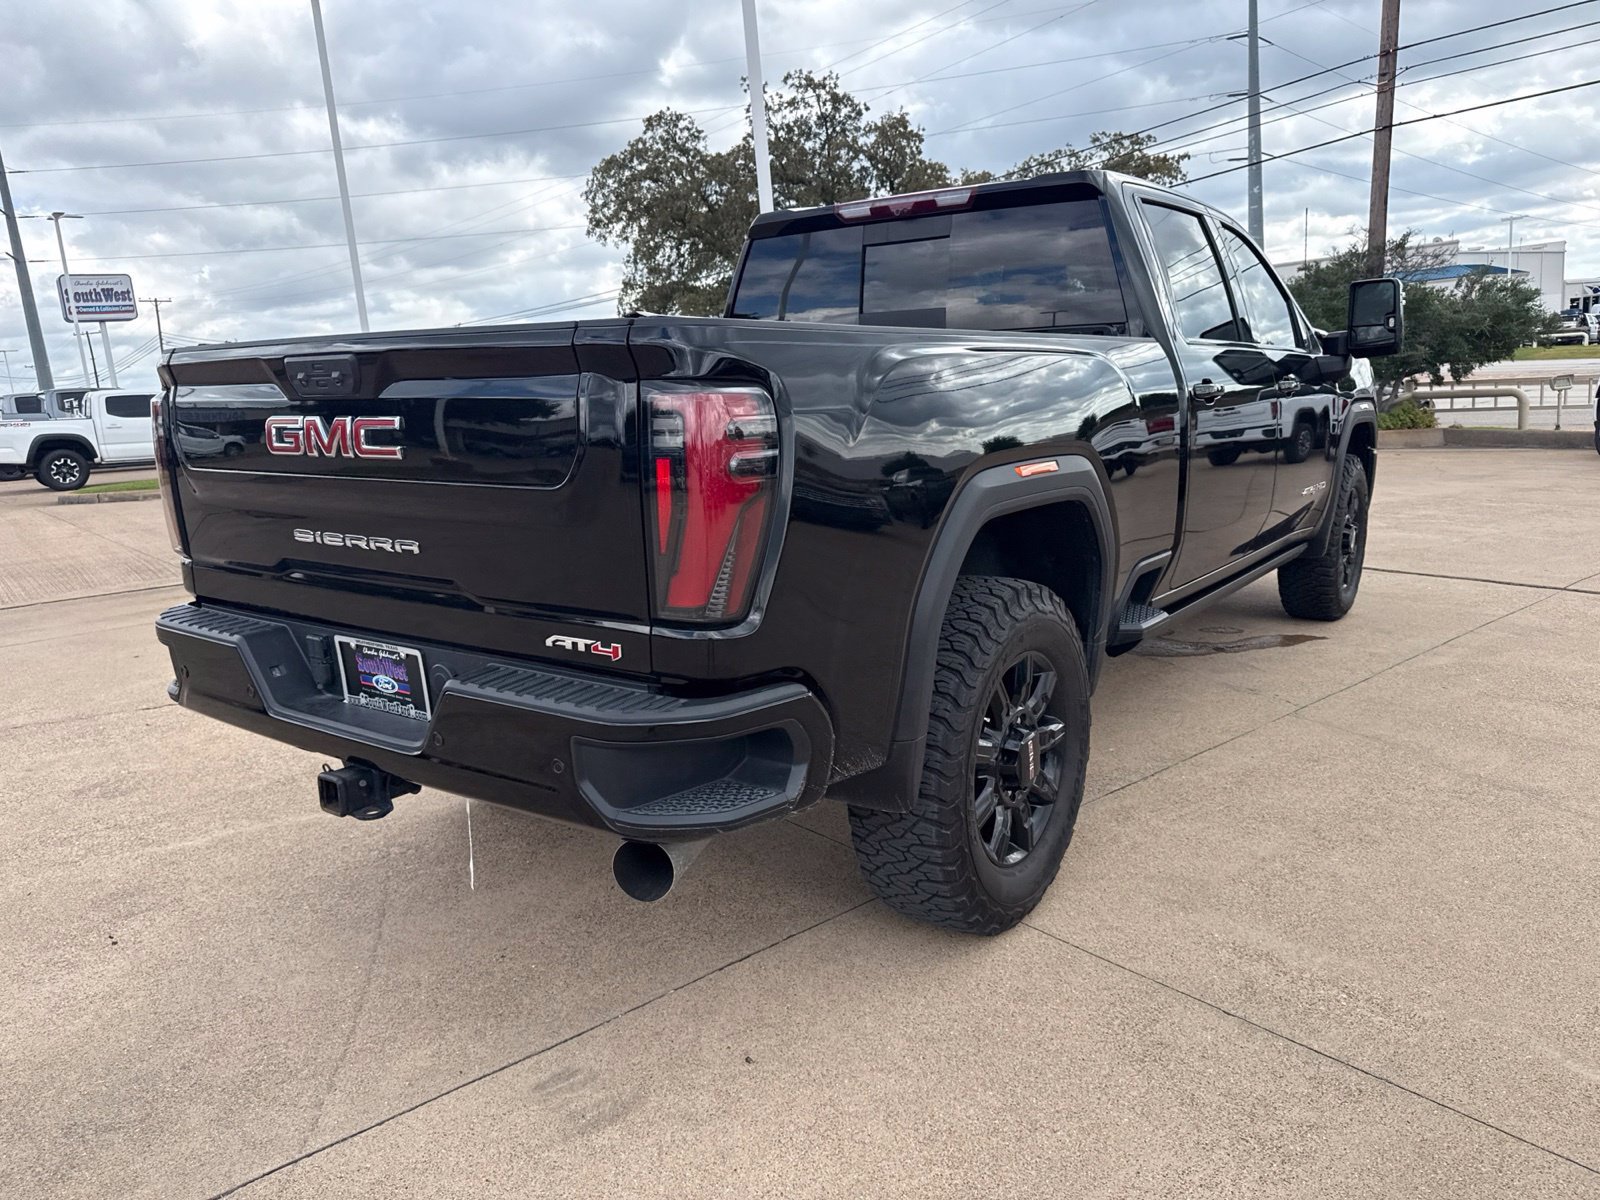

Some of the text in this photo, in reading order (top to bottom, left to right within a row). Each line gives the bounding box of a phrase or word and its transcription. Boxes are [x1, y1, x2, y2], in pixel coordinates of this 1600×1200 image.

[265, 415, 404, 460] GMC
[293, 528, 420, 554] SIERRA
[545, 634, 622, 661] AT4
[355, 653, 409, 682] SouthWest
